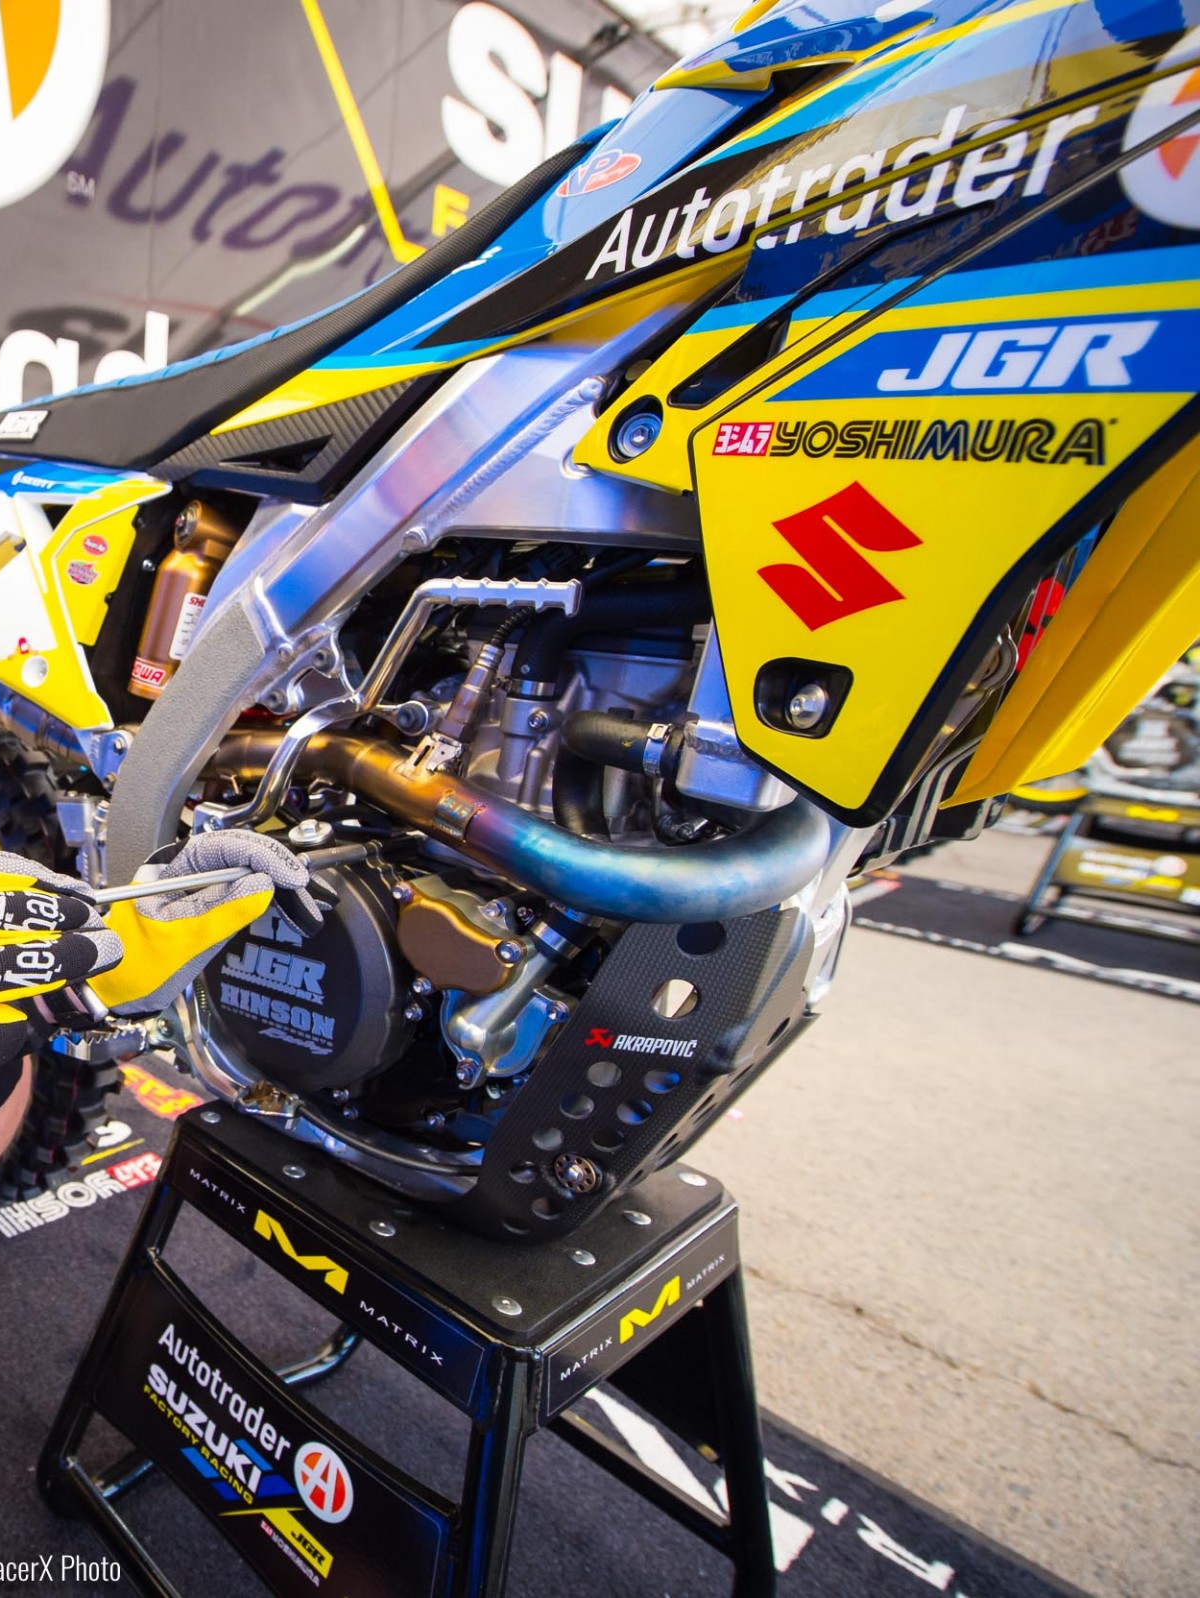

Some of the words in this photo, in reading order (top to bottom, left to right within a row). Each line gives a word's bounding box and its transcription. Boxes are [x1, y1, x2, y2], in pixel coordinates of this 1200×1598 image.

[585, 104, 1101, 281] Autotrader
[877, 320, 1161, 392] JGR
[769, 419, 1107, 466] YOSHIMURA
[226, 942, 326, 996] JGR
[221, 982, 335, 1039] HINSON
[612, 1034, 698, 1058] AKRAPOVIČ
[189, 1168, 247, 1214] MATRIX
[685, 1254, 726, 1290] MATRIX
[359, 1300, 444, 1366] MATRIX
[560, 1336, 613, 1381] MATRIX
[158, 1323, 291, 1460] Autotrader
[143, 1384, 199, 1446] FACTORY
[201, 1446, 253, 1504] RACING
[148, 1363, 262, 1494] SUZUKI
[291, 1531, 326, 1567] JGR
